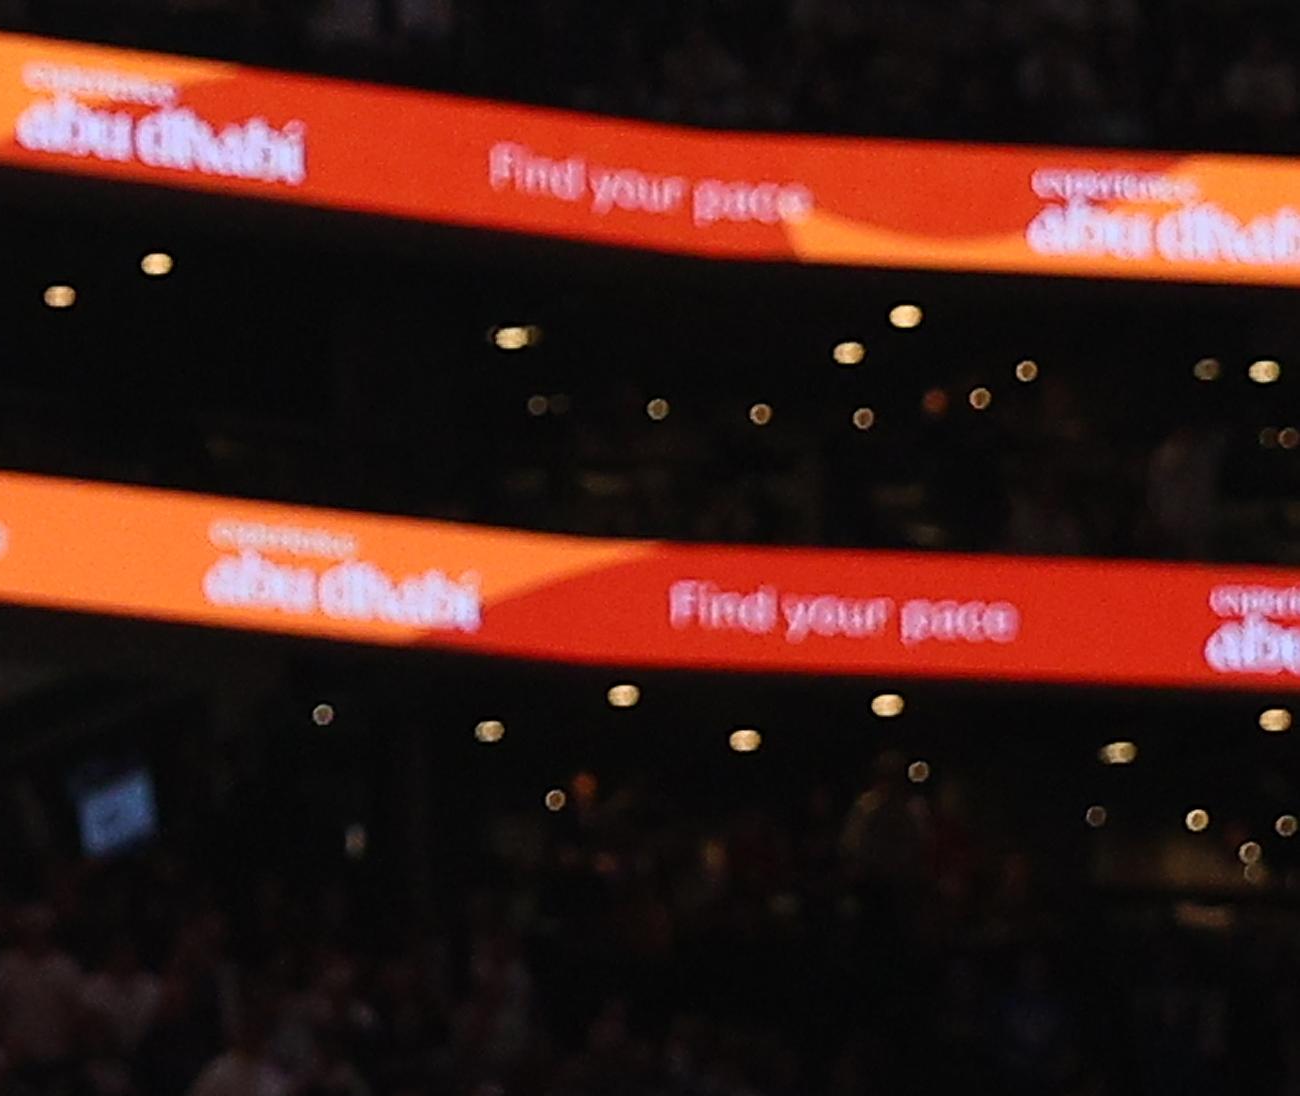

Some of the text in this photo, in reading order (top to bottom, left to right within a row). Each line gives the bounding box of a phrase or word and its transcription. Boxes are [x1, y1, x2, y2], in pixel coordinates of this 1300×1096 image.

[14, 97, 307, 186] abu dhabi
[490, 140, 813, 229] Find your pace
[1026, 199, 1151, 262] abu
[203, 549, 484, 633] abu dhabi
[668, 579, 1020, 648] Find your pace
